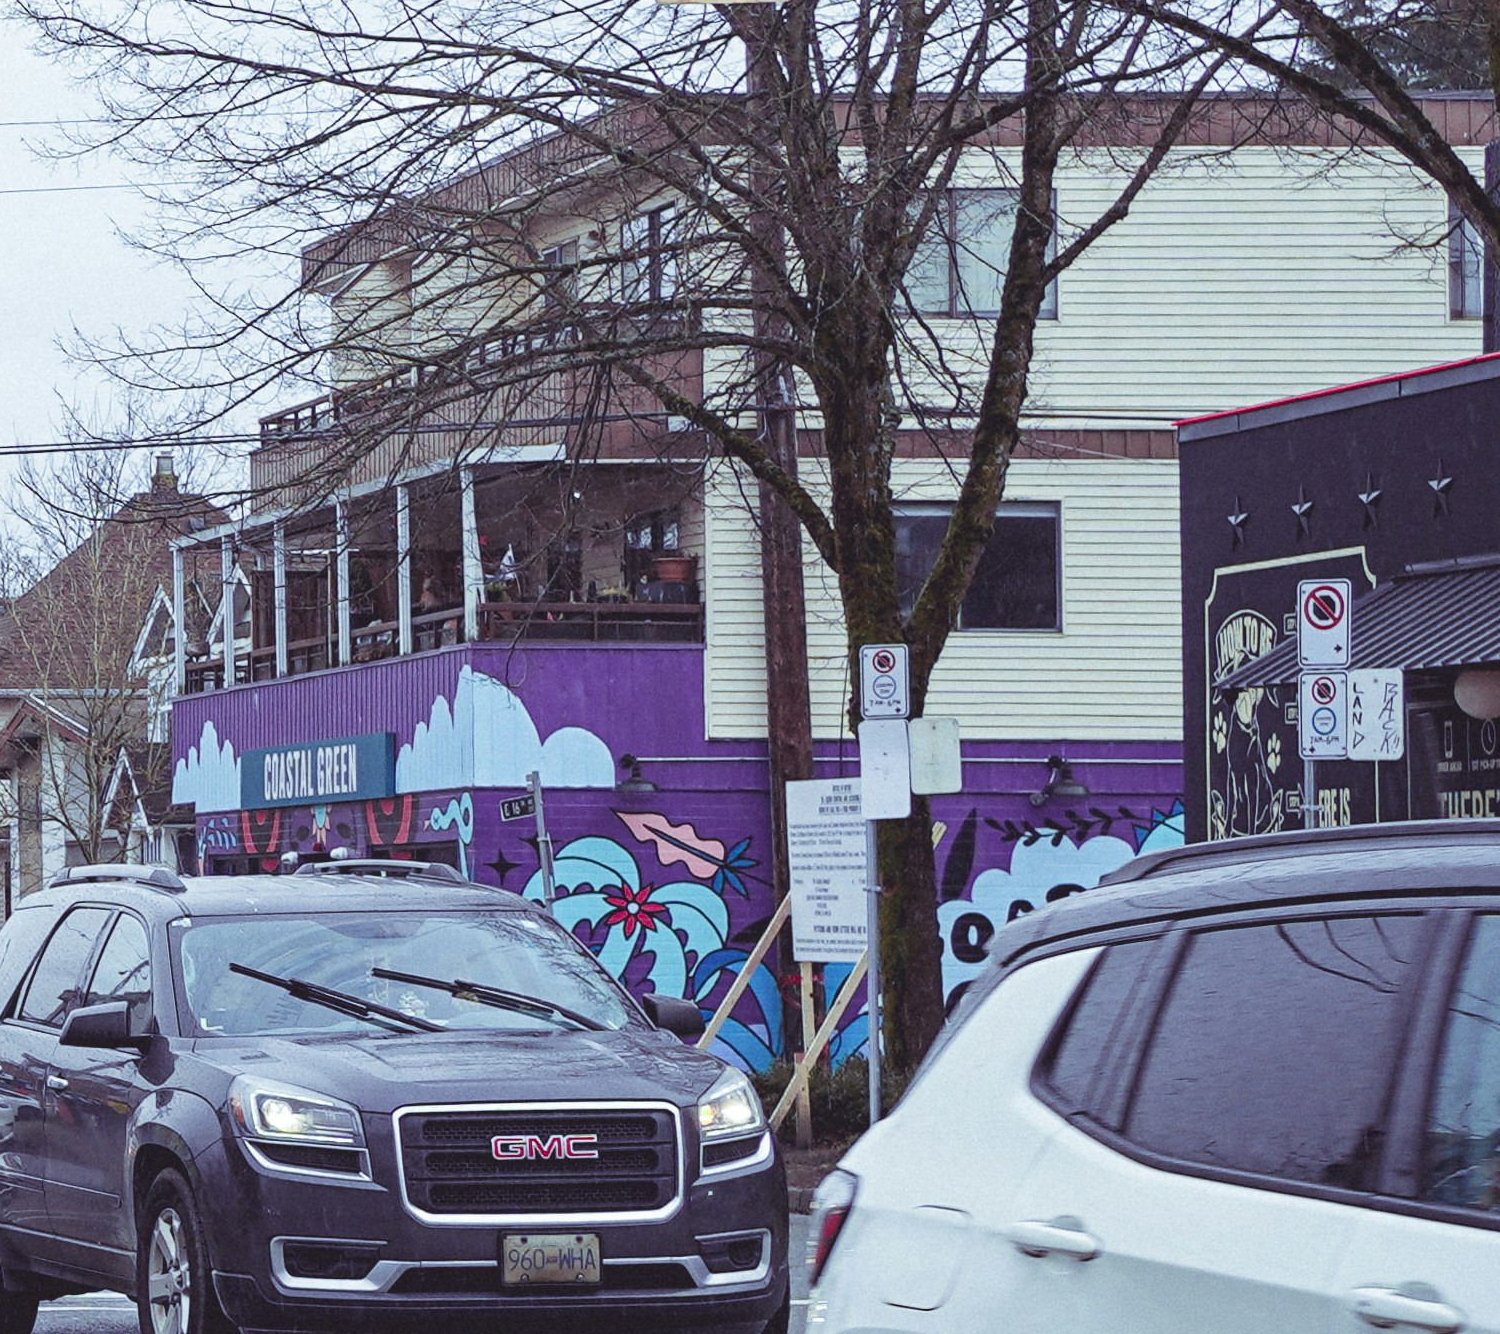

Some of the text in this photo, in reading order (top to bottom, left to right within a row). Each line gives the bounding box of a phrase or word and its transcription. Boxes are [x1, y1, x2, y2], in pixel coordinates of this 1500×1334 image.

[1244, 616, 1258, 654] TO
[263, 743, 358, 801] COASTAL GREEN
[1318, 788, 1350, 828] ERE IS
[491, 1134, 599, 1160] GMC
[508, 1247, 596, 1271] 960 WHA
